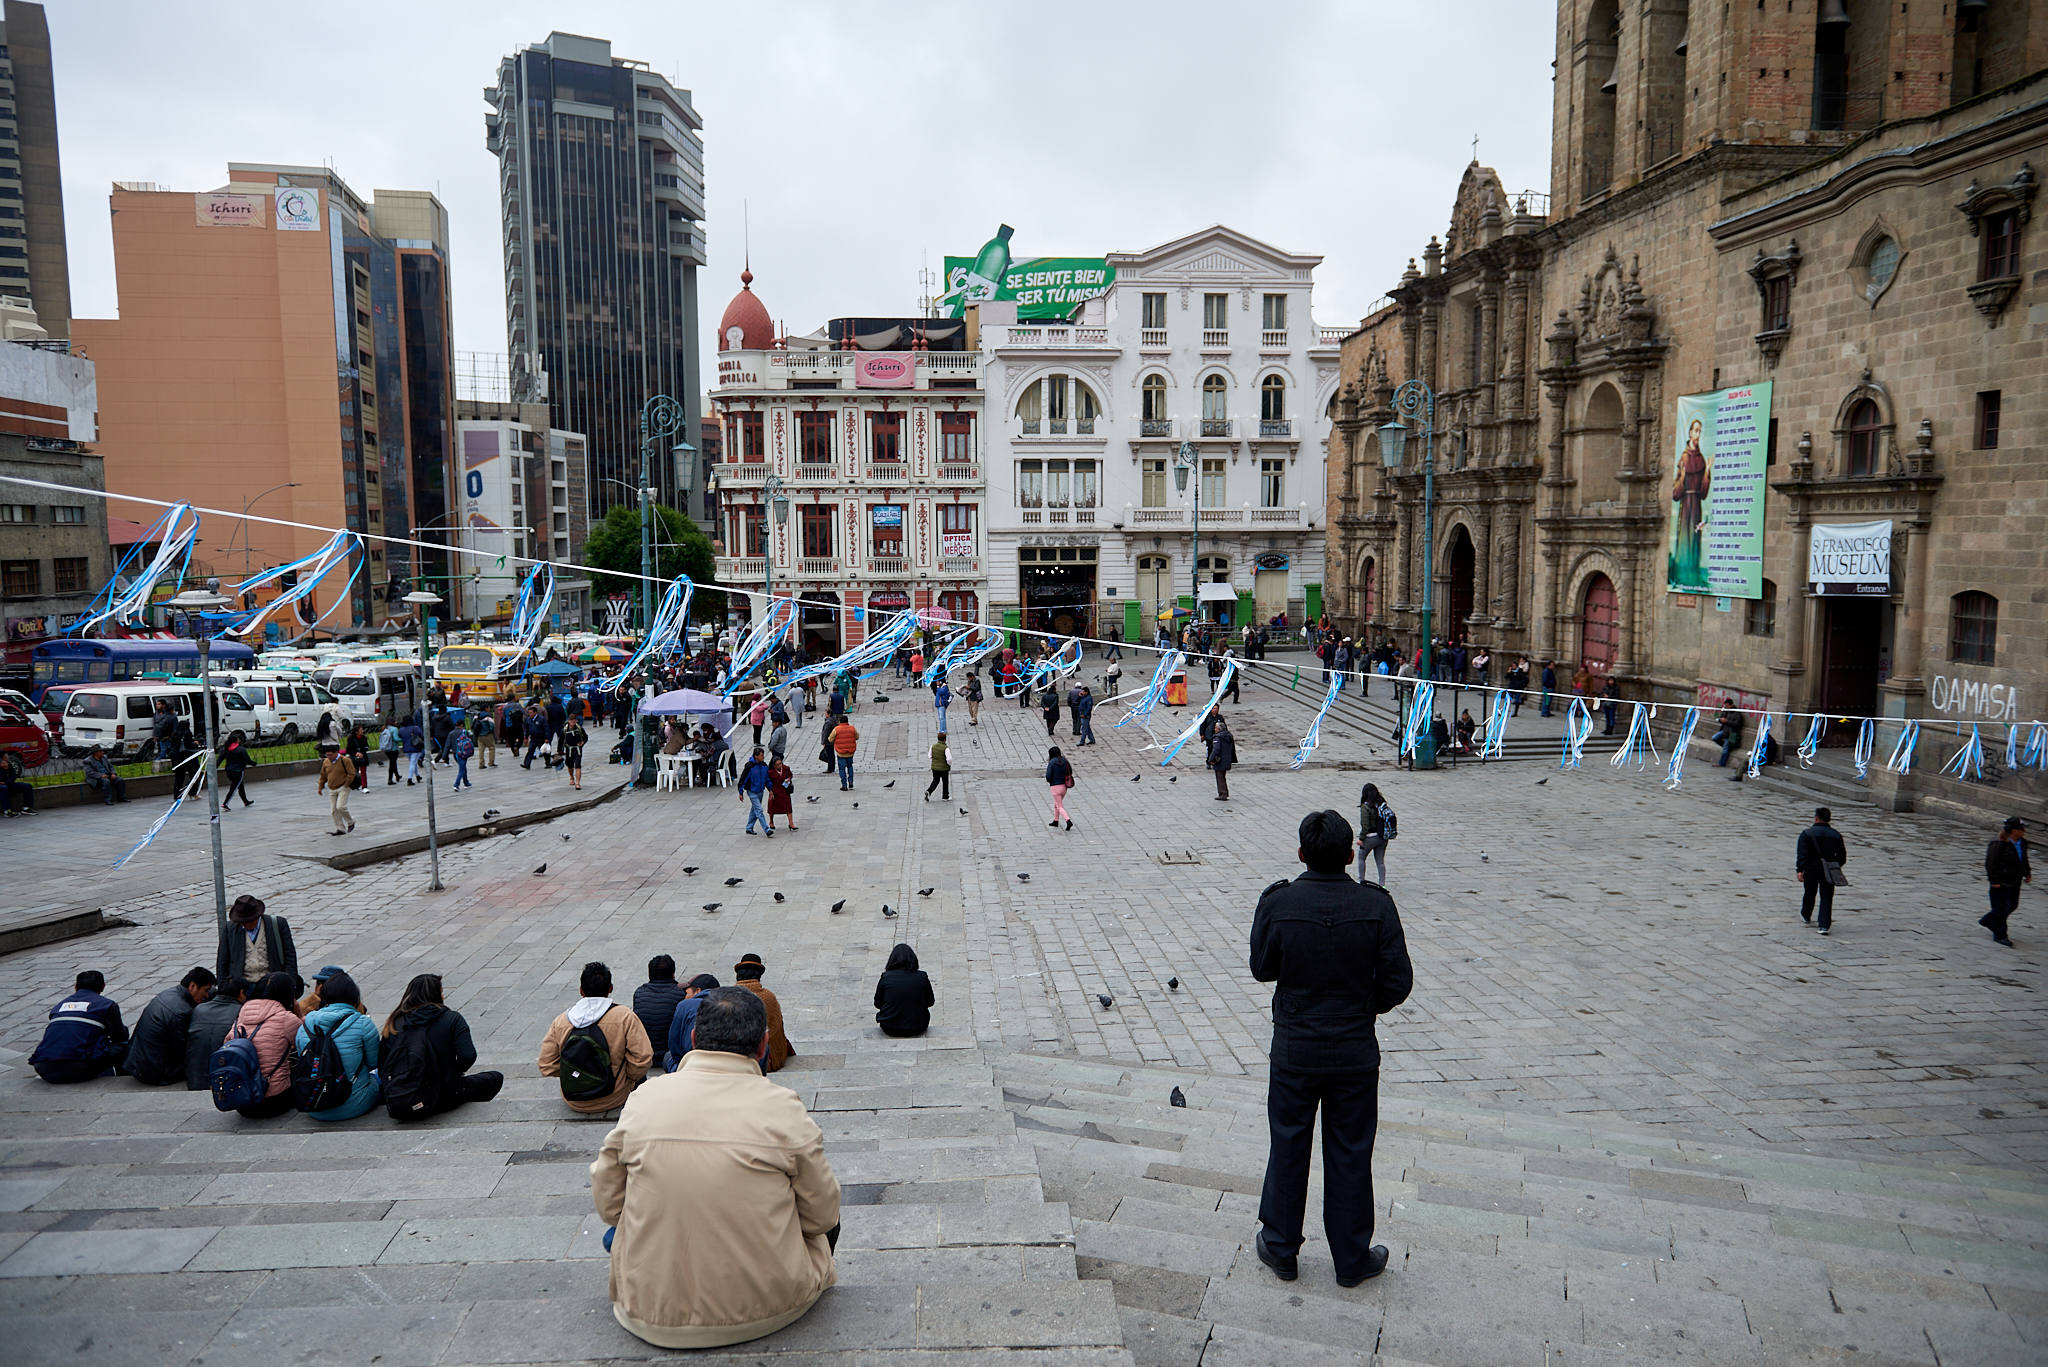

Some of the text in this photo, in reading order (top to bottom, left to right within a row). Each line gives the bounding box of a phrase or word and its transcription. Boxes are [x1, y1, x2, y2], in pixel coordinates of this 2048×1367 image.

[210, 202, 252, 214] Ichuri
[1006, 269, 1106, 289] SE SIENTE BIEN
[1016, 288, 1044, 306] SER
[1046, 284, 1066, 303] TÚ
[868, 361, 901, 370] Ichuri
[1020, 536, 1100, 546] KAUTSCH
[1822, 536, 1890, 552] FRANCISCO
[944, 546, 972, 555] MERCED
[1813, 553, 1889, 575] MUSEUM
[1857, 584, 1886, 593] Entrance
[61, 615, 77, 626] AGFA
[1932, 673, 2016, 720] QAMASA
